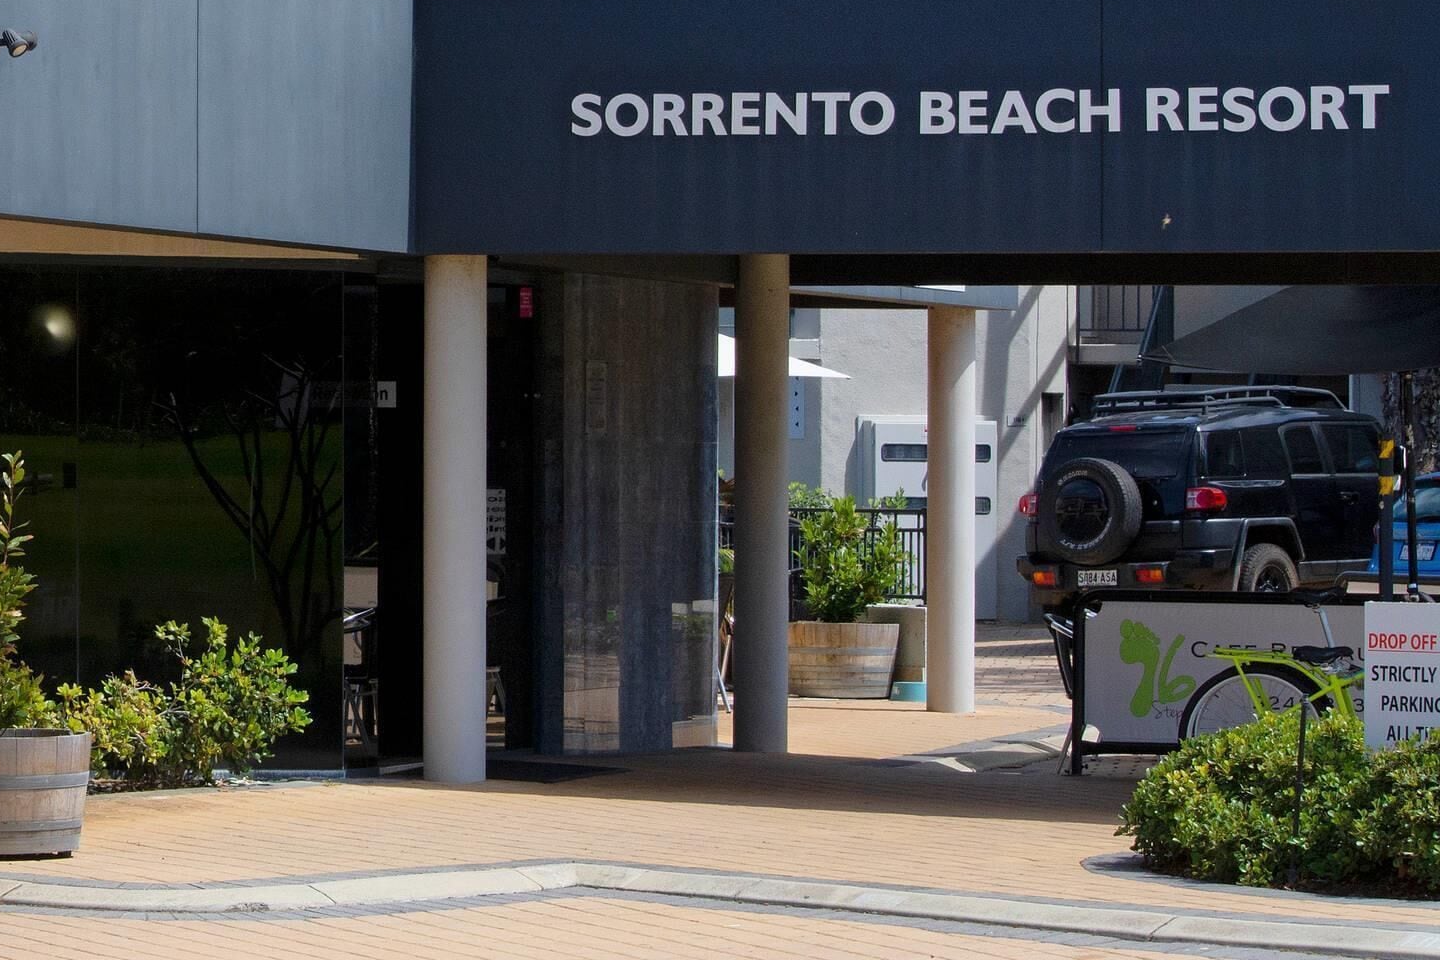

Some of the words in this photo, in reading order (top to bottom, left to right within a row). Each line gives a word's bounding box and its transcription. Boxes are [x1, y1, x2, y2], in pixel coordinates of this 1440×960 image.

[570, 90, 896, 137] SORRENTO
[919, 88, 1122, 135] BEACH
[1145, 84, 1390, 133] RESORT
[1368, 633, 1407, 649] DROP
[1411, 634, 1437, 650] OFF
[1371, 665, 1437, 683] STRICTLY
[1386, 725, 1410, 741] ALL
